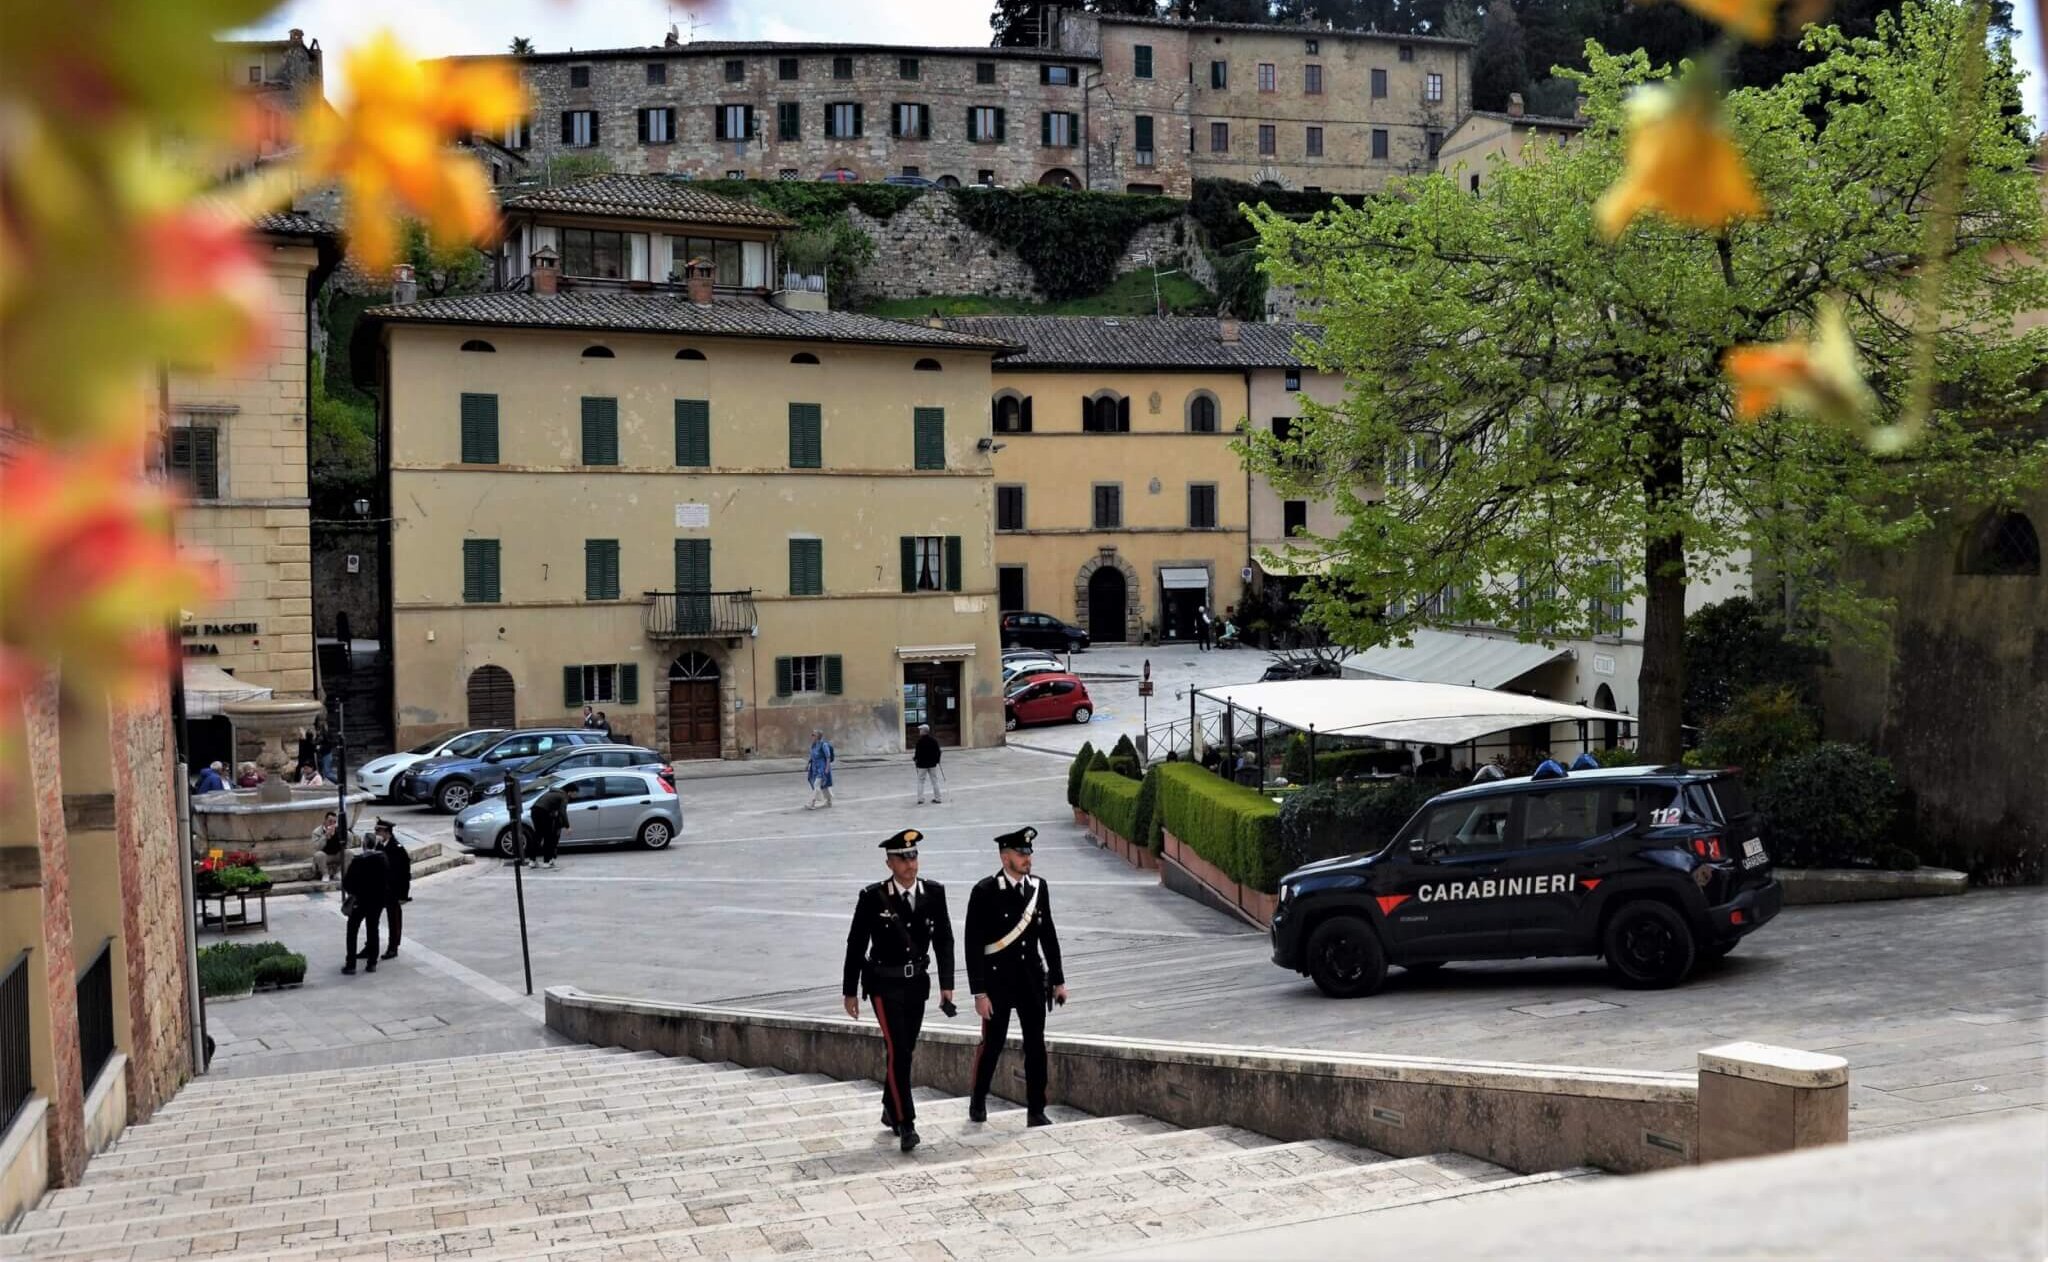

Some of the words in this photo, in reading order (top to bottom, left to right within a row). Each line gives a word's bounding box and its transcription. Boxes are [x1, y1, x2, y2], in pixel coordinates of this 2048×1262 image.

[204, 623, 257, 635] PASCHI
[1650, 807, 1680, 825] 112
[1418, 873, 1575, 902] CARABINIERI
